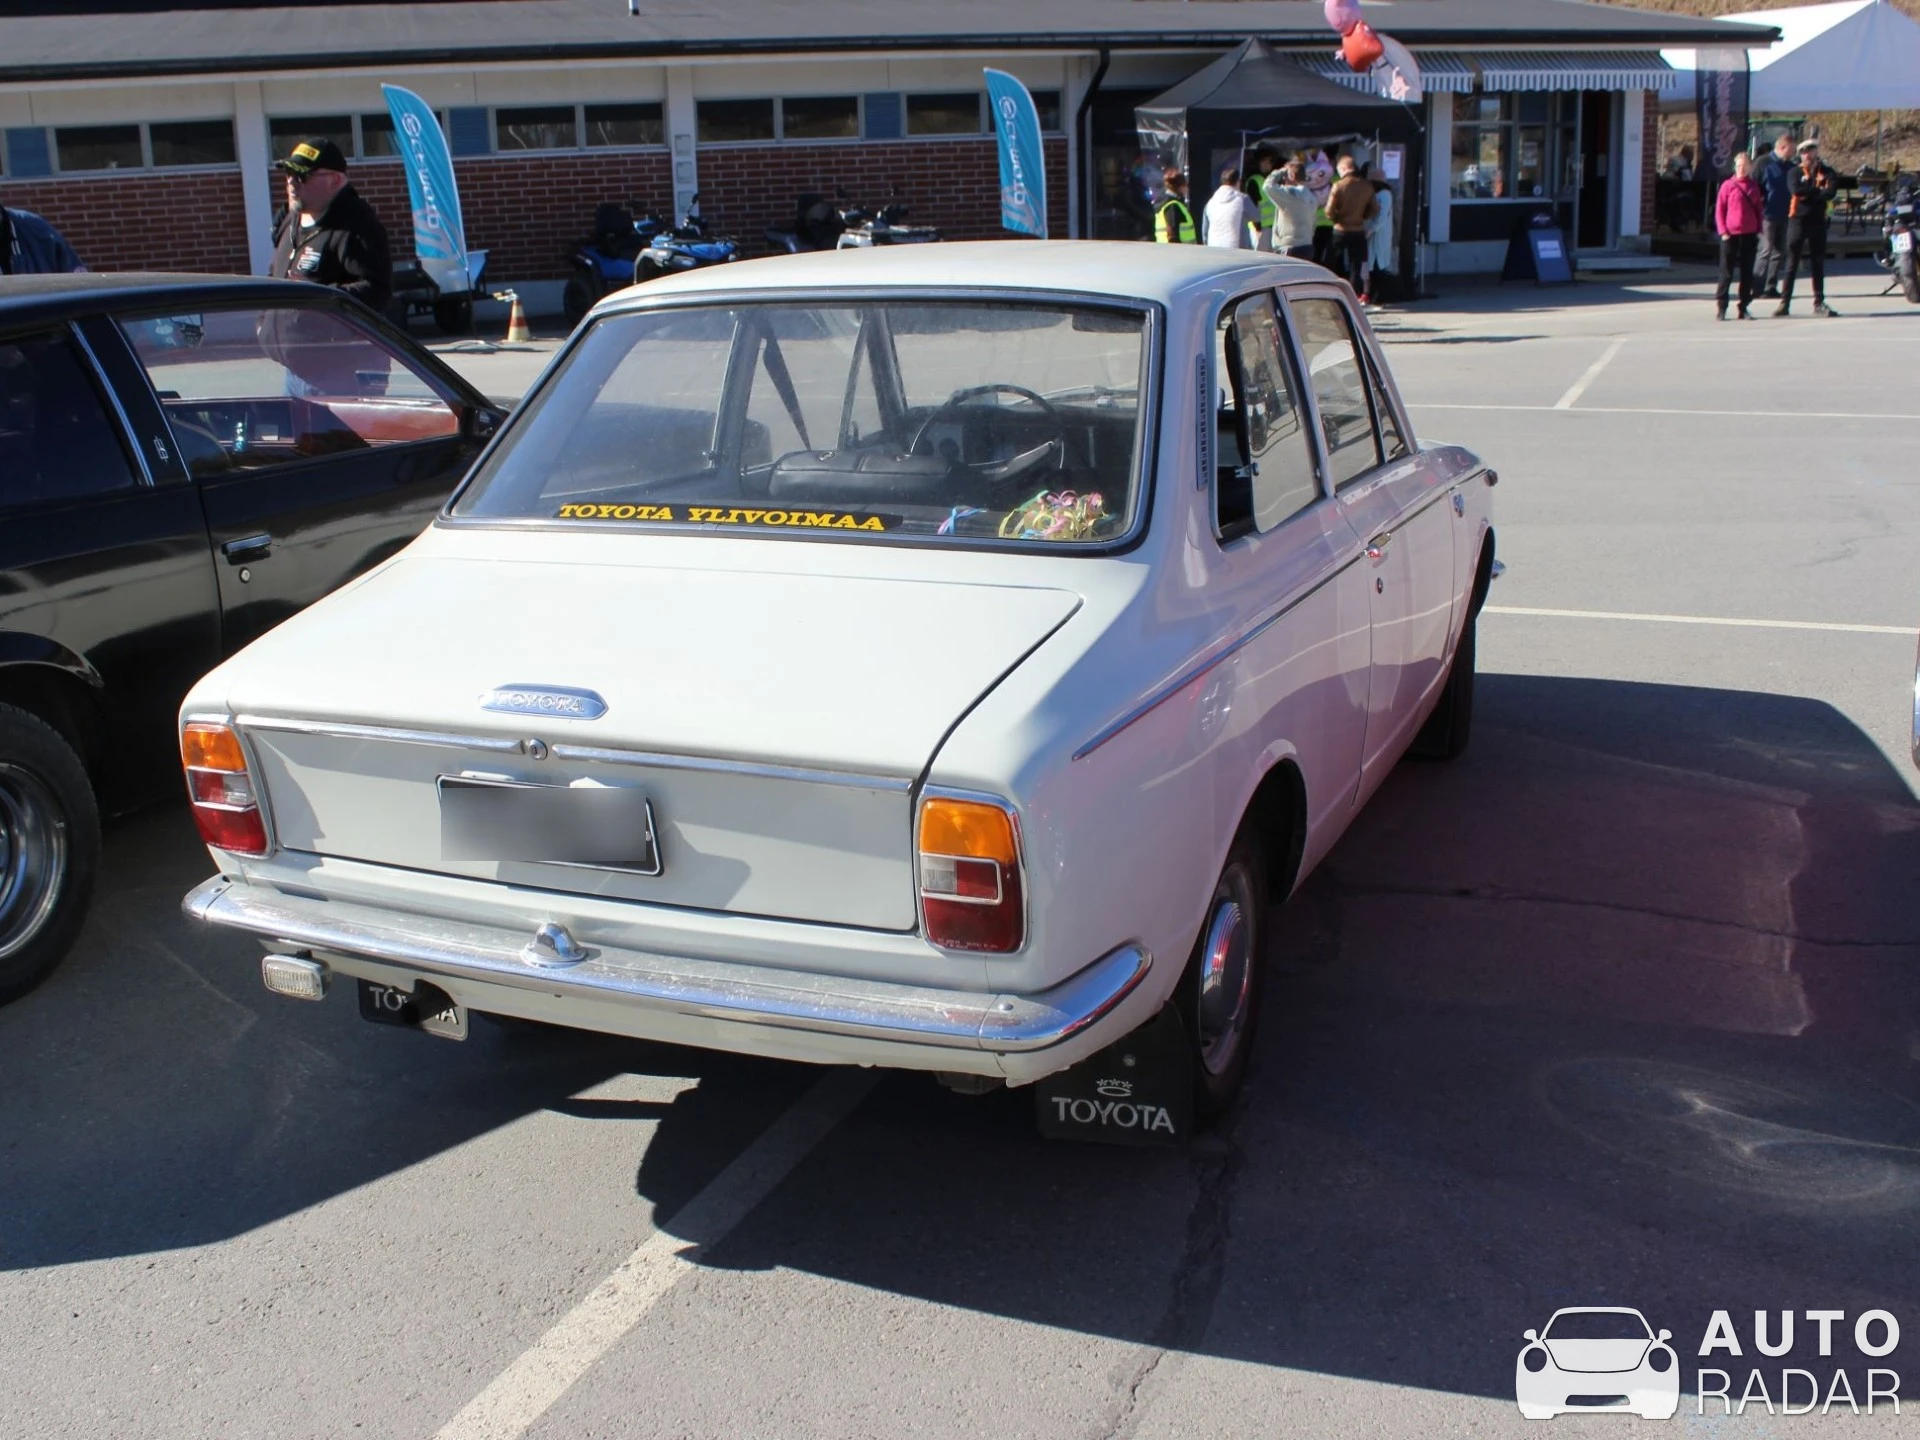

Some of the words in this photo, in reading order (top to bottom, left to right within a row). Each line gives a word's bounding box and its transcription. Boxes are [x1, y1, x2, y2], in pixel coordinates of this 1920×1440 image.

[559, 503, 673, 520] TOYOTA
[688, 508, 885, 531] YLIVOIMAA
[496, 692, 584, 713] TOYOTA
[369, 986, 458, 1025] TOA
[1051, 1096, 1175, 1134] TOYOTA
